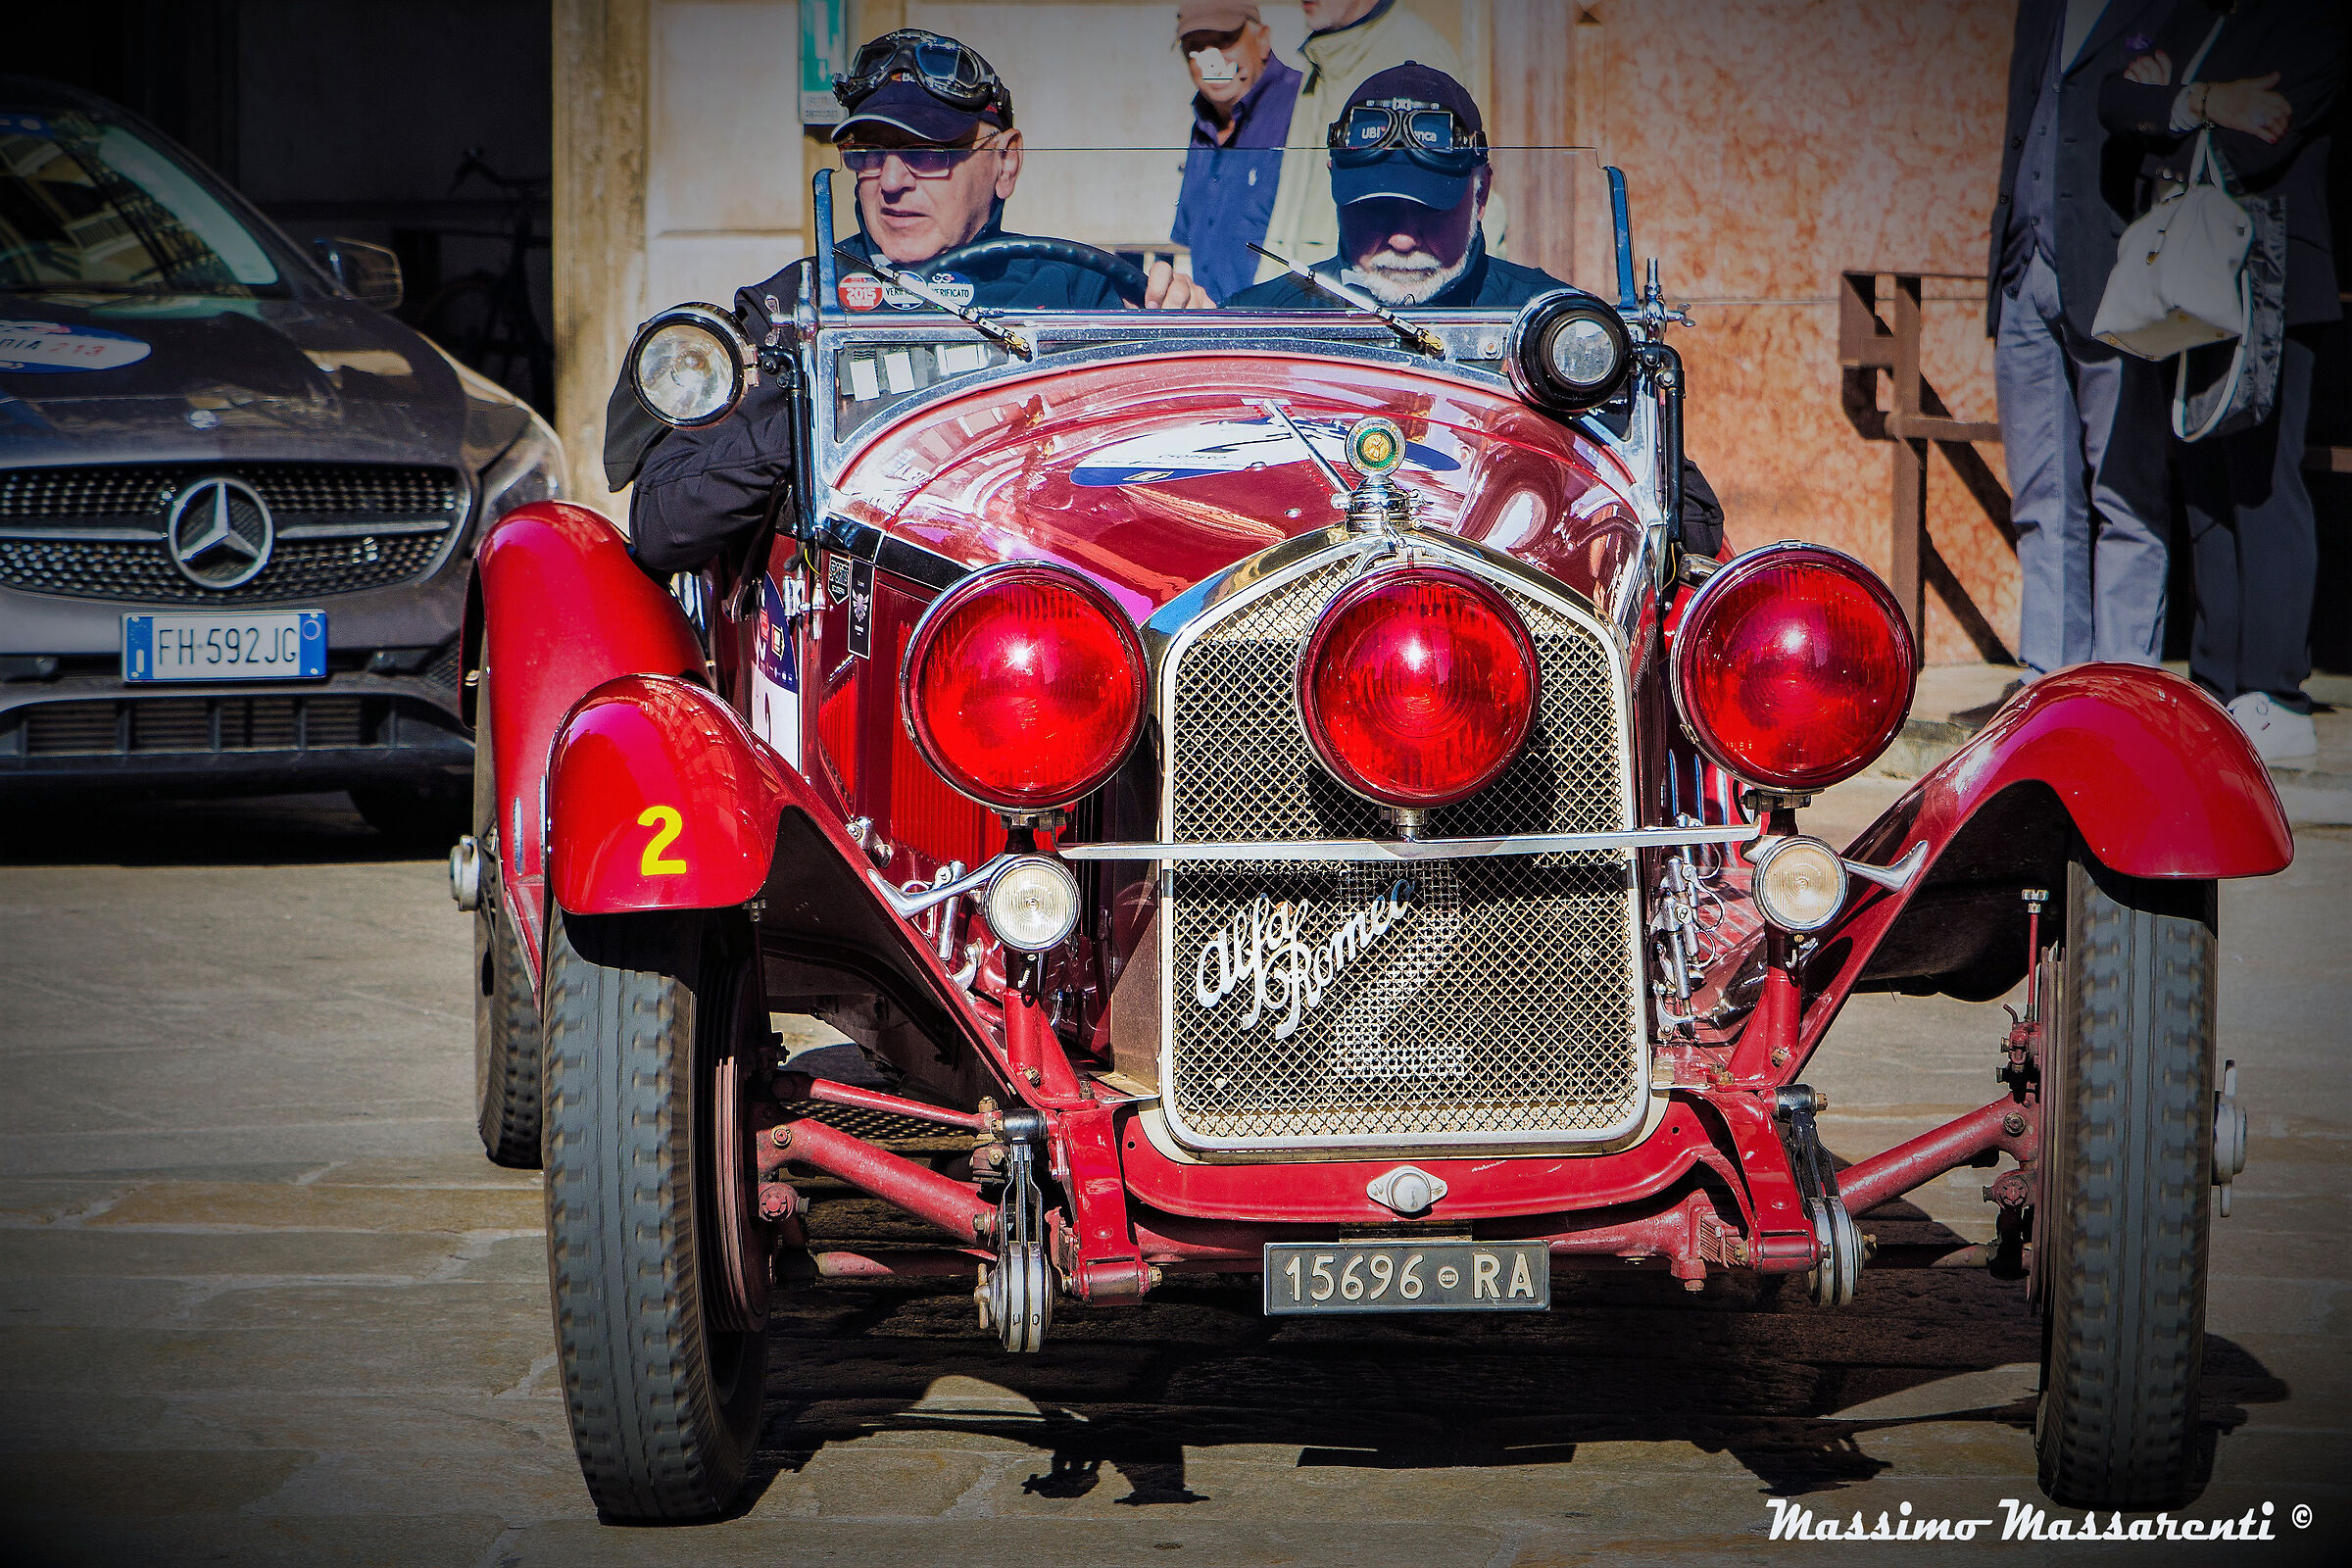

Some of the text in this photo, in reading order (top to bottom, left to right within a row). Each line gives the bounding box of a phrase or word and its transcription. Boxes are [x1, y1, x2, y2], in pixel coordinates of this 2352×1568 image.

[1361, 126, 1381, 139] UBI
[846, 287, 877, 300] 2015
[932, 288, 969, 298] ERIFICATO
[637, 805, 687, 876] 2
[1261, 879, 1415, 1041] Romeo
[1284, 1253, 1425, 1301] 15696
[1472, 1252, 1535, 1299] RA
